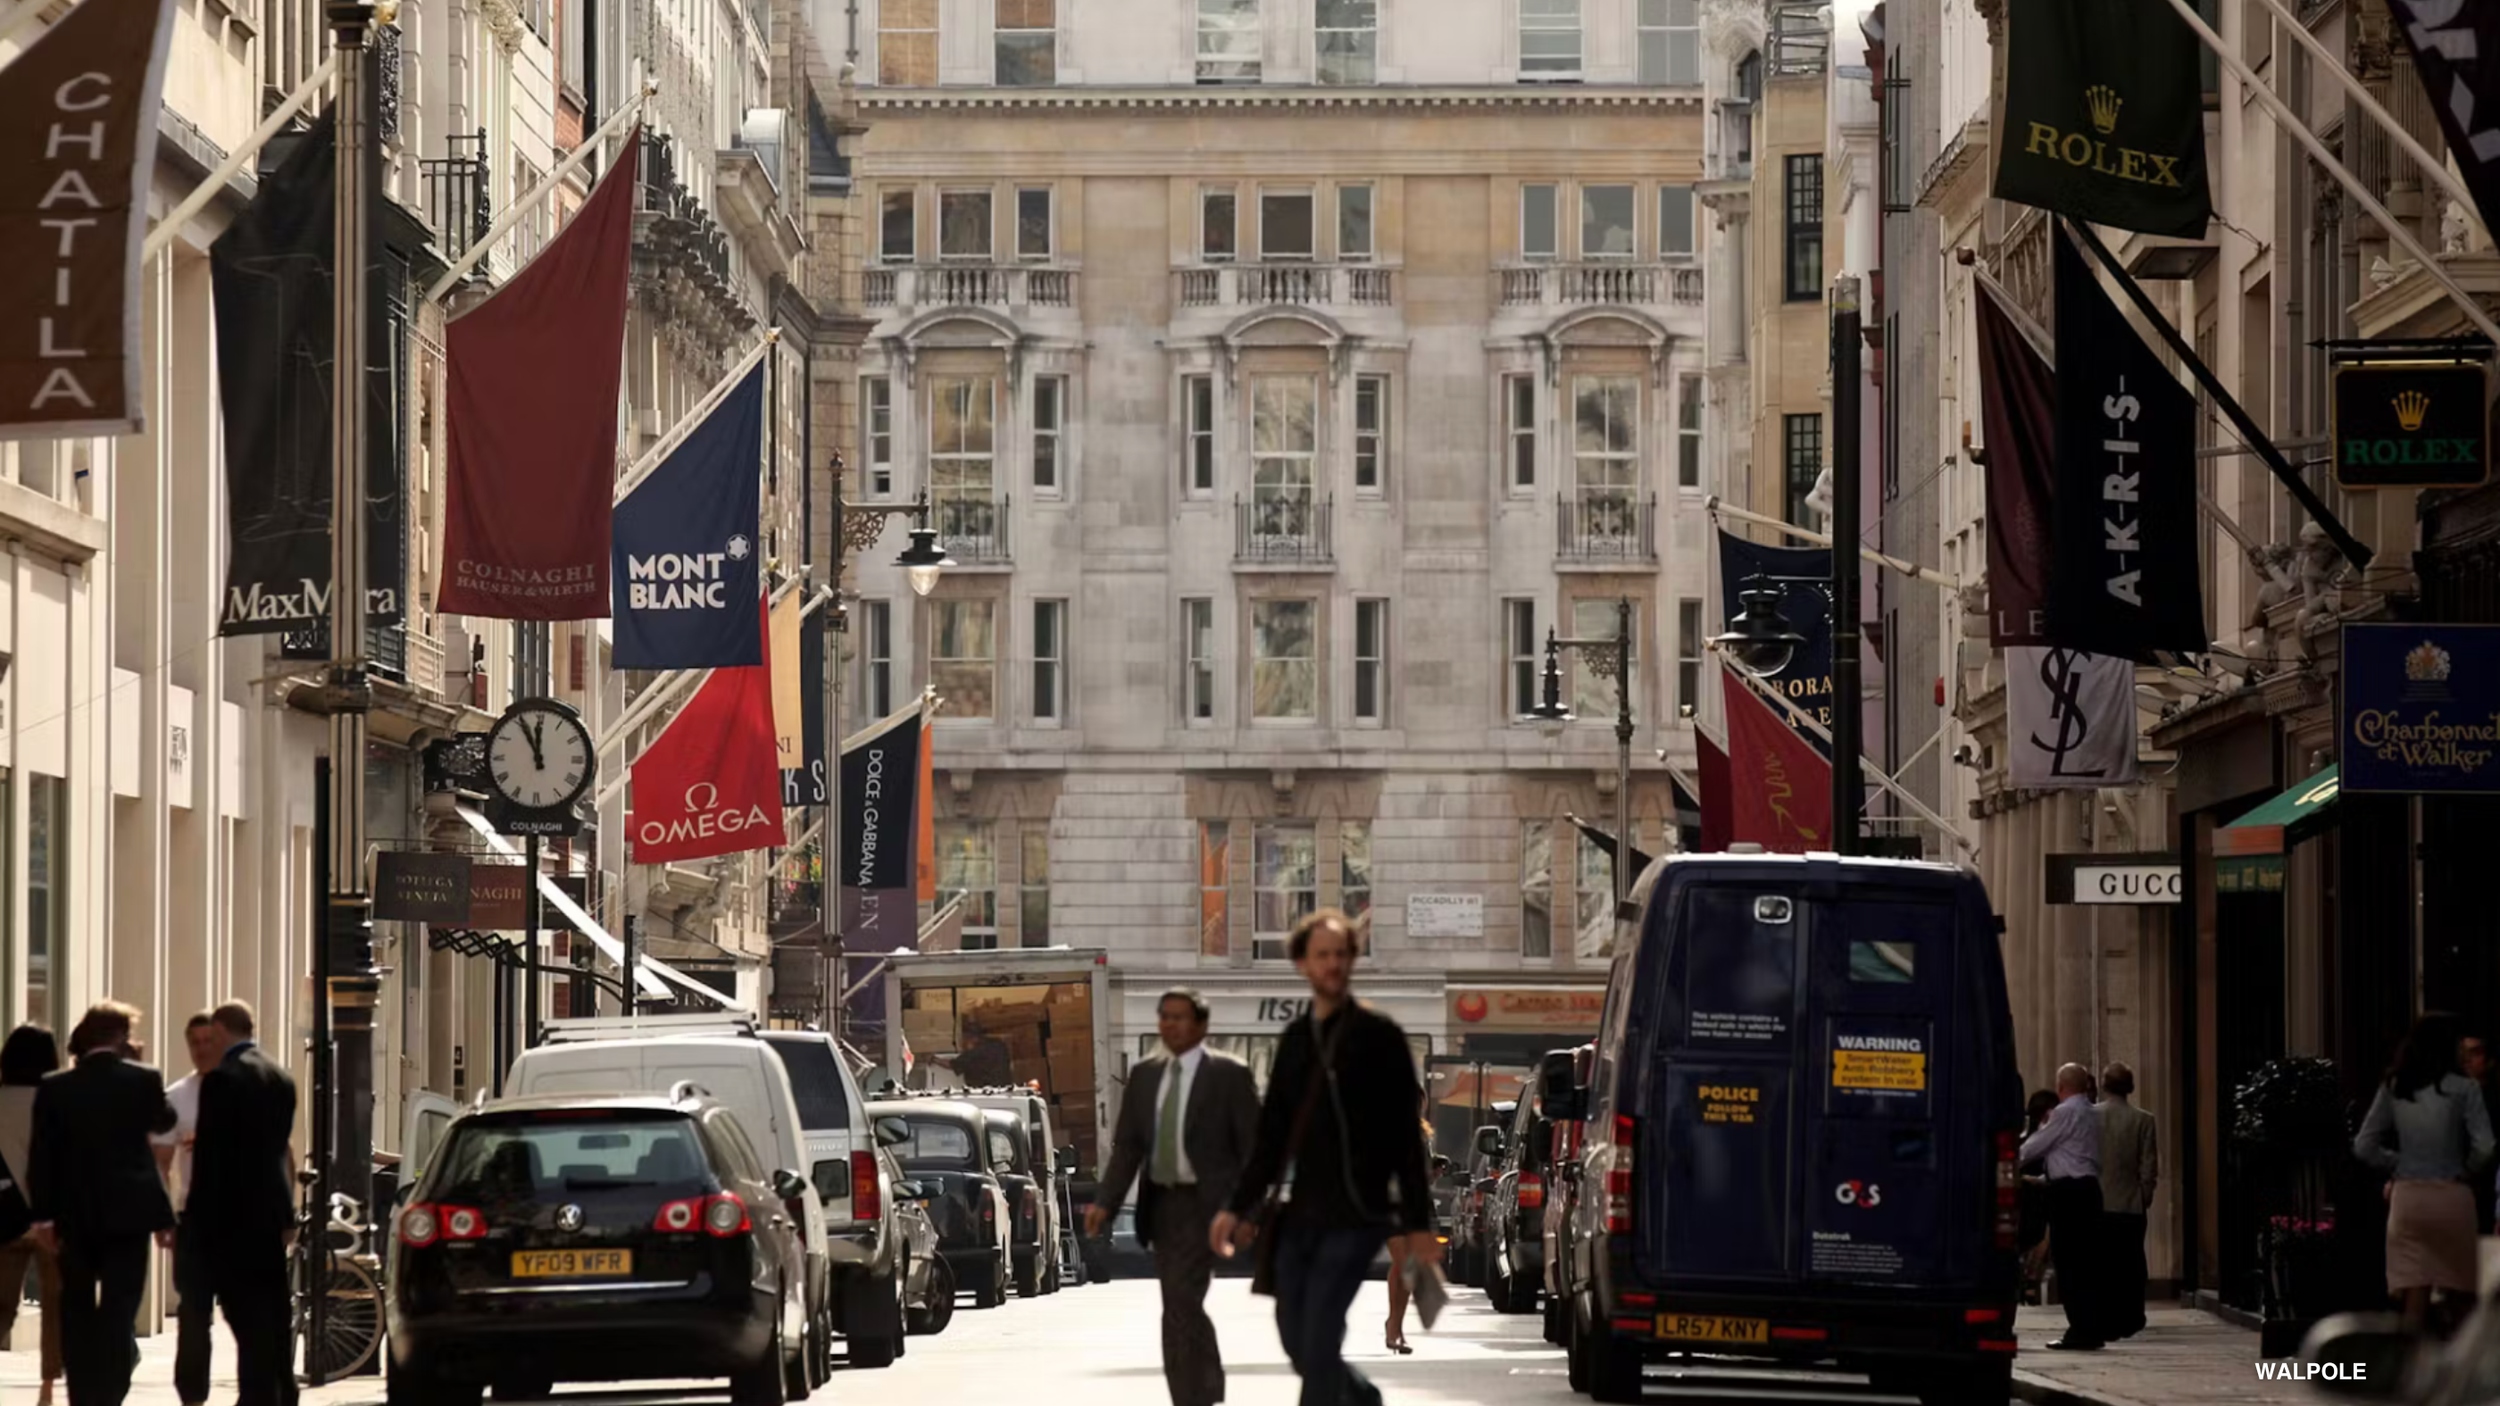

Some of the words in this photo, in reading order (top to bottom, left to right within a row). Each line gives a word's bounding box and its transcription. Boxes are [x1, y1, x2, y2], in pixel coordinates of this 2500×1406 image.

[2025, 121, 2184, 188] ROLEX
[30, 71, 113, 409] CHATILA
[2344, 438, 2479, 466] ROLEX
[456, 558, 596, 584] COLNAGHI
[628, 553, 726, 582] MONT
[223, 576, 398, 624] MaxMra
[629, 581, 726, 610] BLANC
[2378, 742, 2399, 761] et
[2399, 740, 2492, 773] Walker
[865, 750, 883, 799] DOLCE
[510, 821, 563, 833] COLNAGHI
[640, 804, 771, 845] OMEGA
[858, 807, 879, 886] GABBANA
[1412, 896, 1464, 905] PICCADILLY
[1838, 1035, 1922, 1051] WARNING
[1698, 1086, 1759, 1102] POLICE
[1707, 1103, 1750, 1113] FOLLOW
[521, 1253, 575, 1274] YF09
[581, 1251, 622, 1273] WFR
[1662, 1316, 1717, 1337] LR57
[1721, 1318, 1760, 1340] KNY
